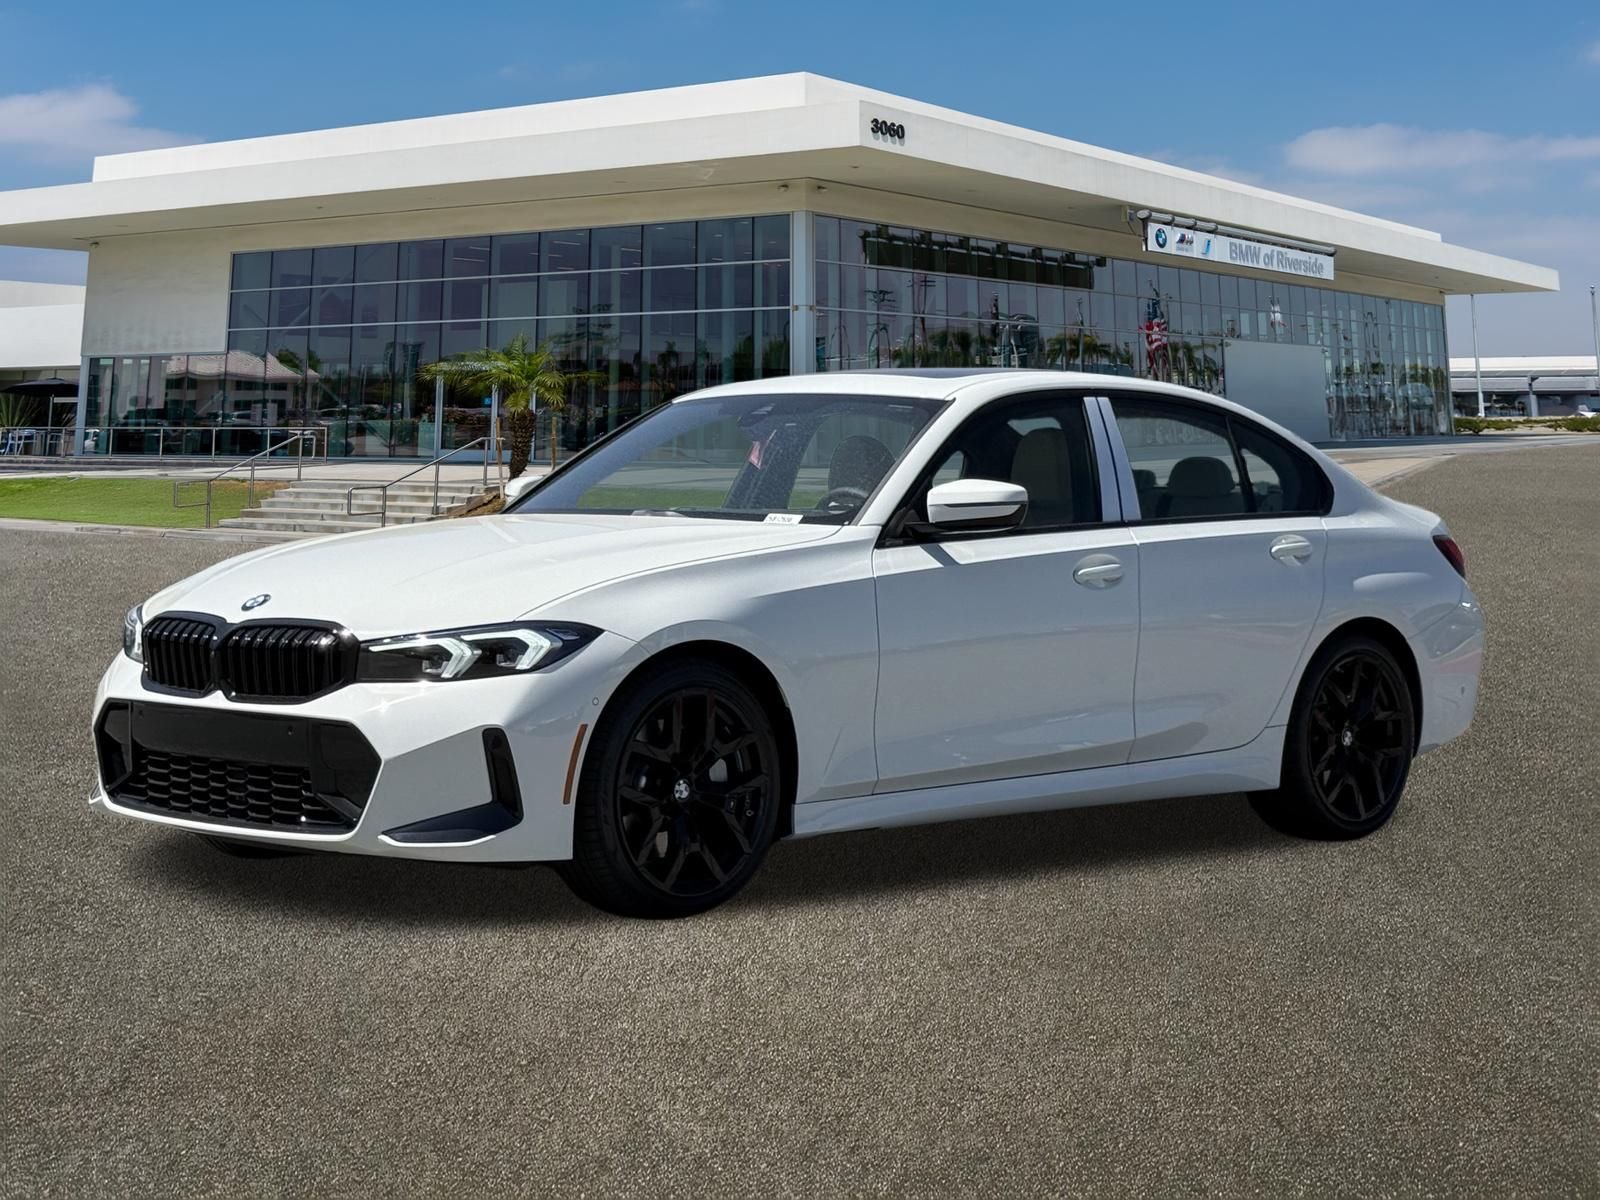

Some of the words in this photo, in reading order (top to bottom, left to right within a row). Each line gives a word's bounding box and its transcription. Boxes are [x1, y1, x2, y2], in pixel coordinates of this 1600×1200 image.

[870, 118, 905, 139] 3060
[1229, 241, 1261, 265] BMW
[1263, 249, 1275, 267] of
[1276, 250, 1324, 275] Riverside
